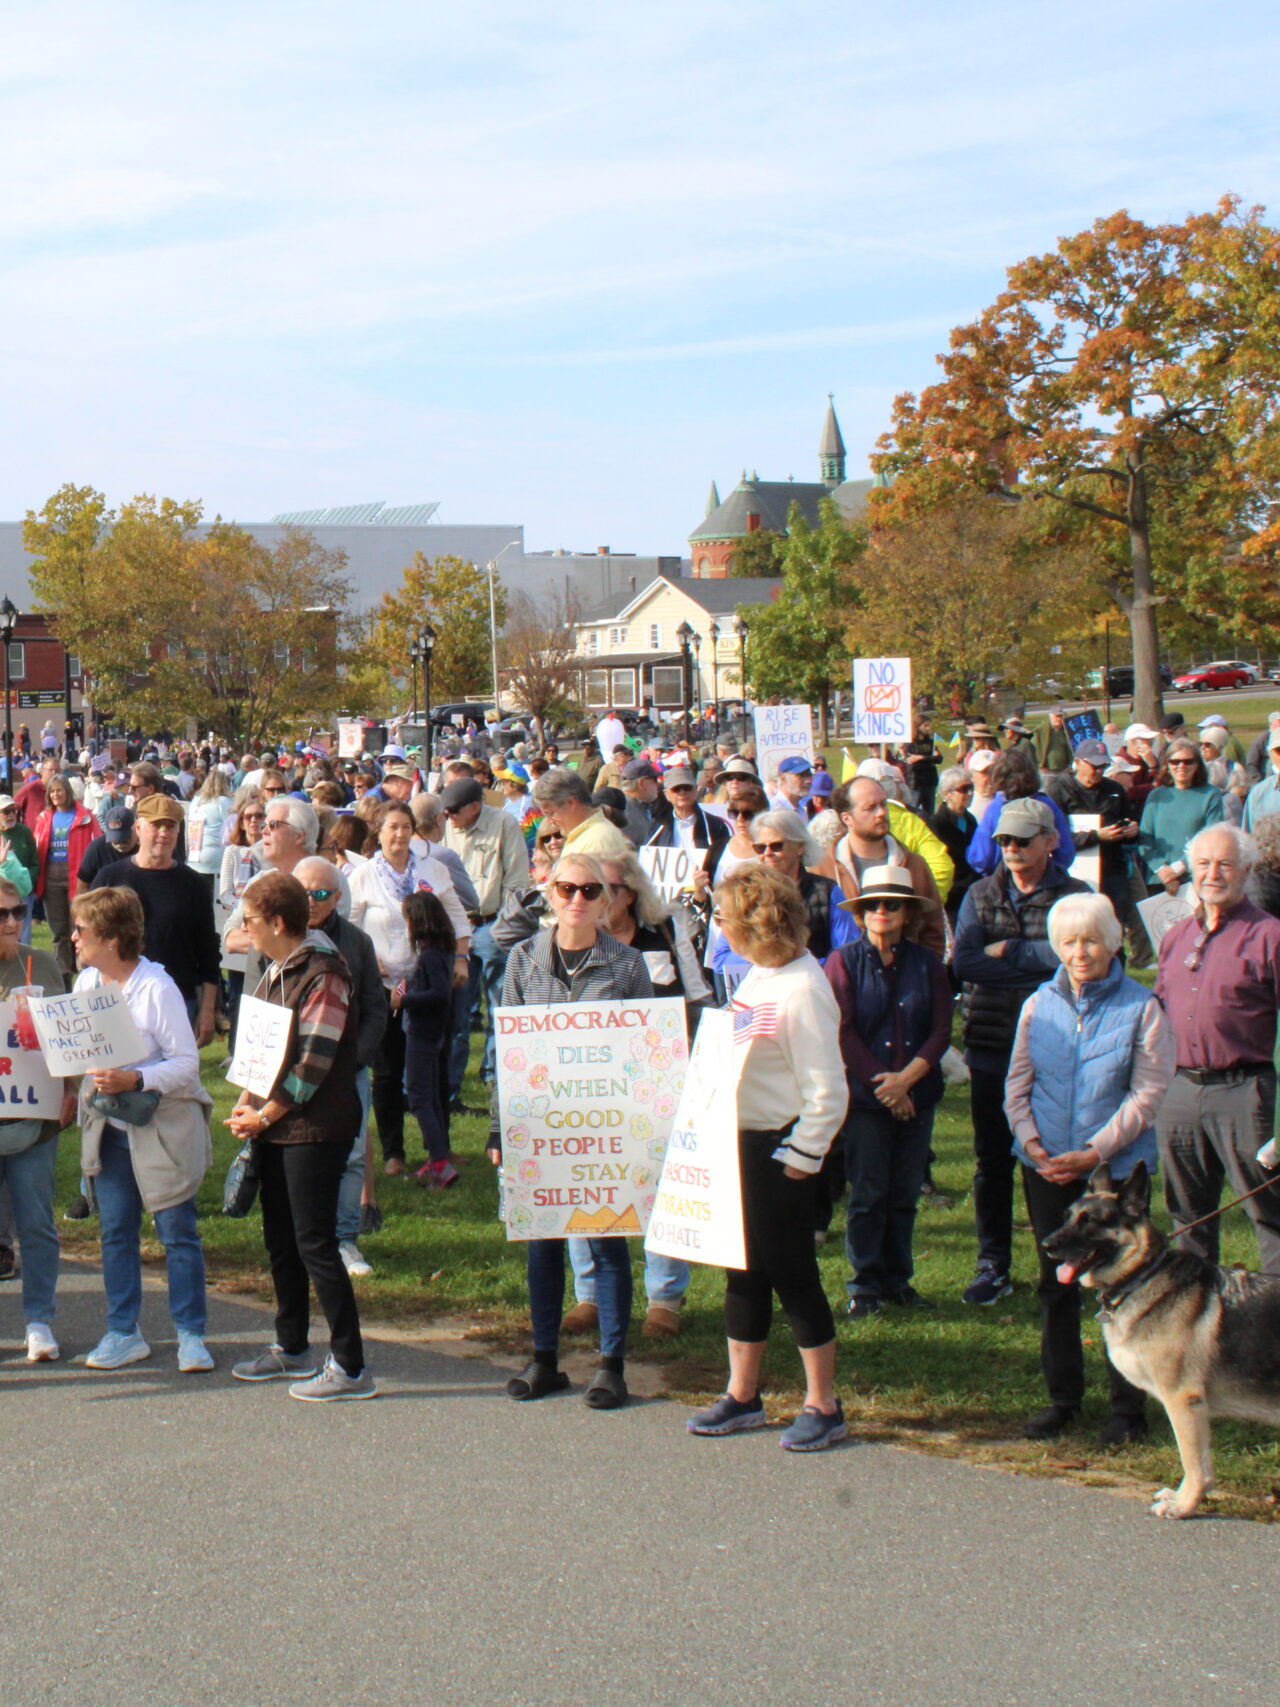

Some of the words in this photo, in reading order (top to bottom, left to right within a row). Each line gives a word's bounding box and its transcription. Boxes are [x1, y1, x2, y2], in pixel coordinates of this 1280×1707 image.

[869, 662, 895, 685] NO
[773, 720, 792, 732] UP
[856, 713, 905, 736] KINGS
[760, 732, 807, 746] AMERICA
[651, 847, 689, 884] NO
[36, 998, 84, 1020] HATE
[88, 994, 119, 1012] WILL
[56, 1016, 93, 1034] NOT
[245, 1013, 281, 1049] SAVE
[497, 1008, 651, 1035] DEMOCRACY
[49, 1036, 81, 1049] MAKE
[556, 1045, 613, 1064] DIES
[549, 1077, 629, 1099] WHEN
[545, 1109, 624, 1129] GOOD
[532, 1136, 623, 1156] PEOPLE
[571, 1163, 631, 1182] STAY
[533, 1186, 619, 1207] SILENT
[666, 1223, 702, 1249] HATE
